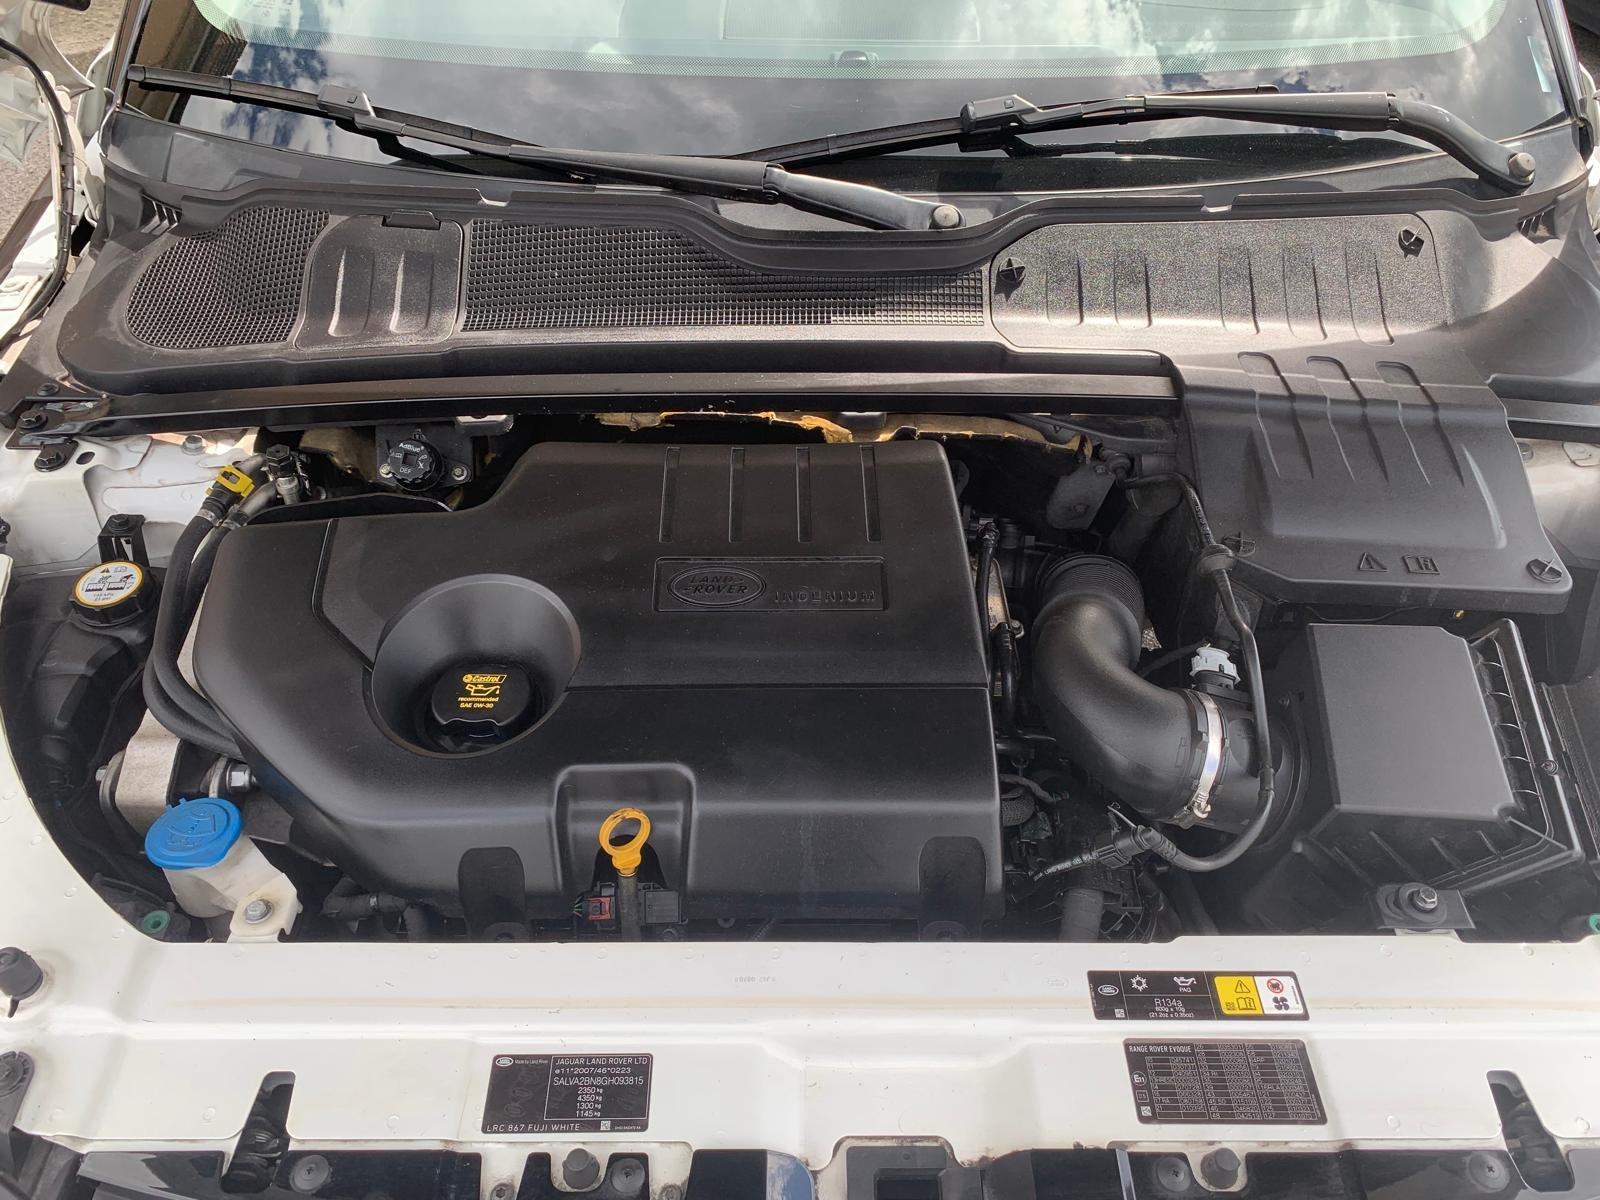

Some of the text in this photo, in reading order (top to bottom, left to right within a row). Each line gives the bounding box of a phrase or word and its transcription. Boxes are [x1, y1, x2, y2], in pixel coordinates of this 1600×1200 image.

[690, 575, 733, 584] LAND
[693, 584, 748, 594] ROVER
[1154, 998, 1182, 1007] R134a
[1128, 1045, 1192, 1053] RANGE ROVER EVOQUE
[555, 1057, 584, 1065] JAGUAR
[586, 1057, 607, 1065] LAND
